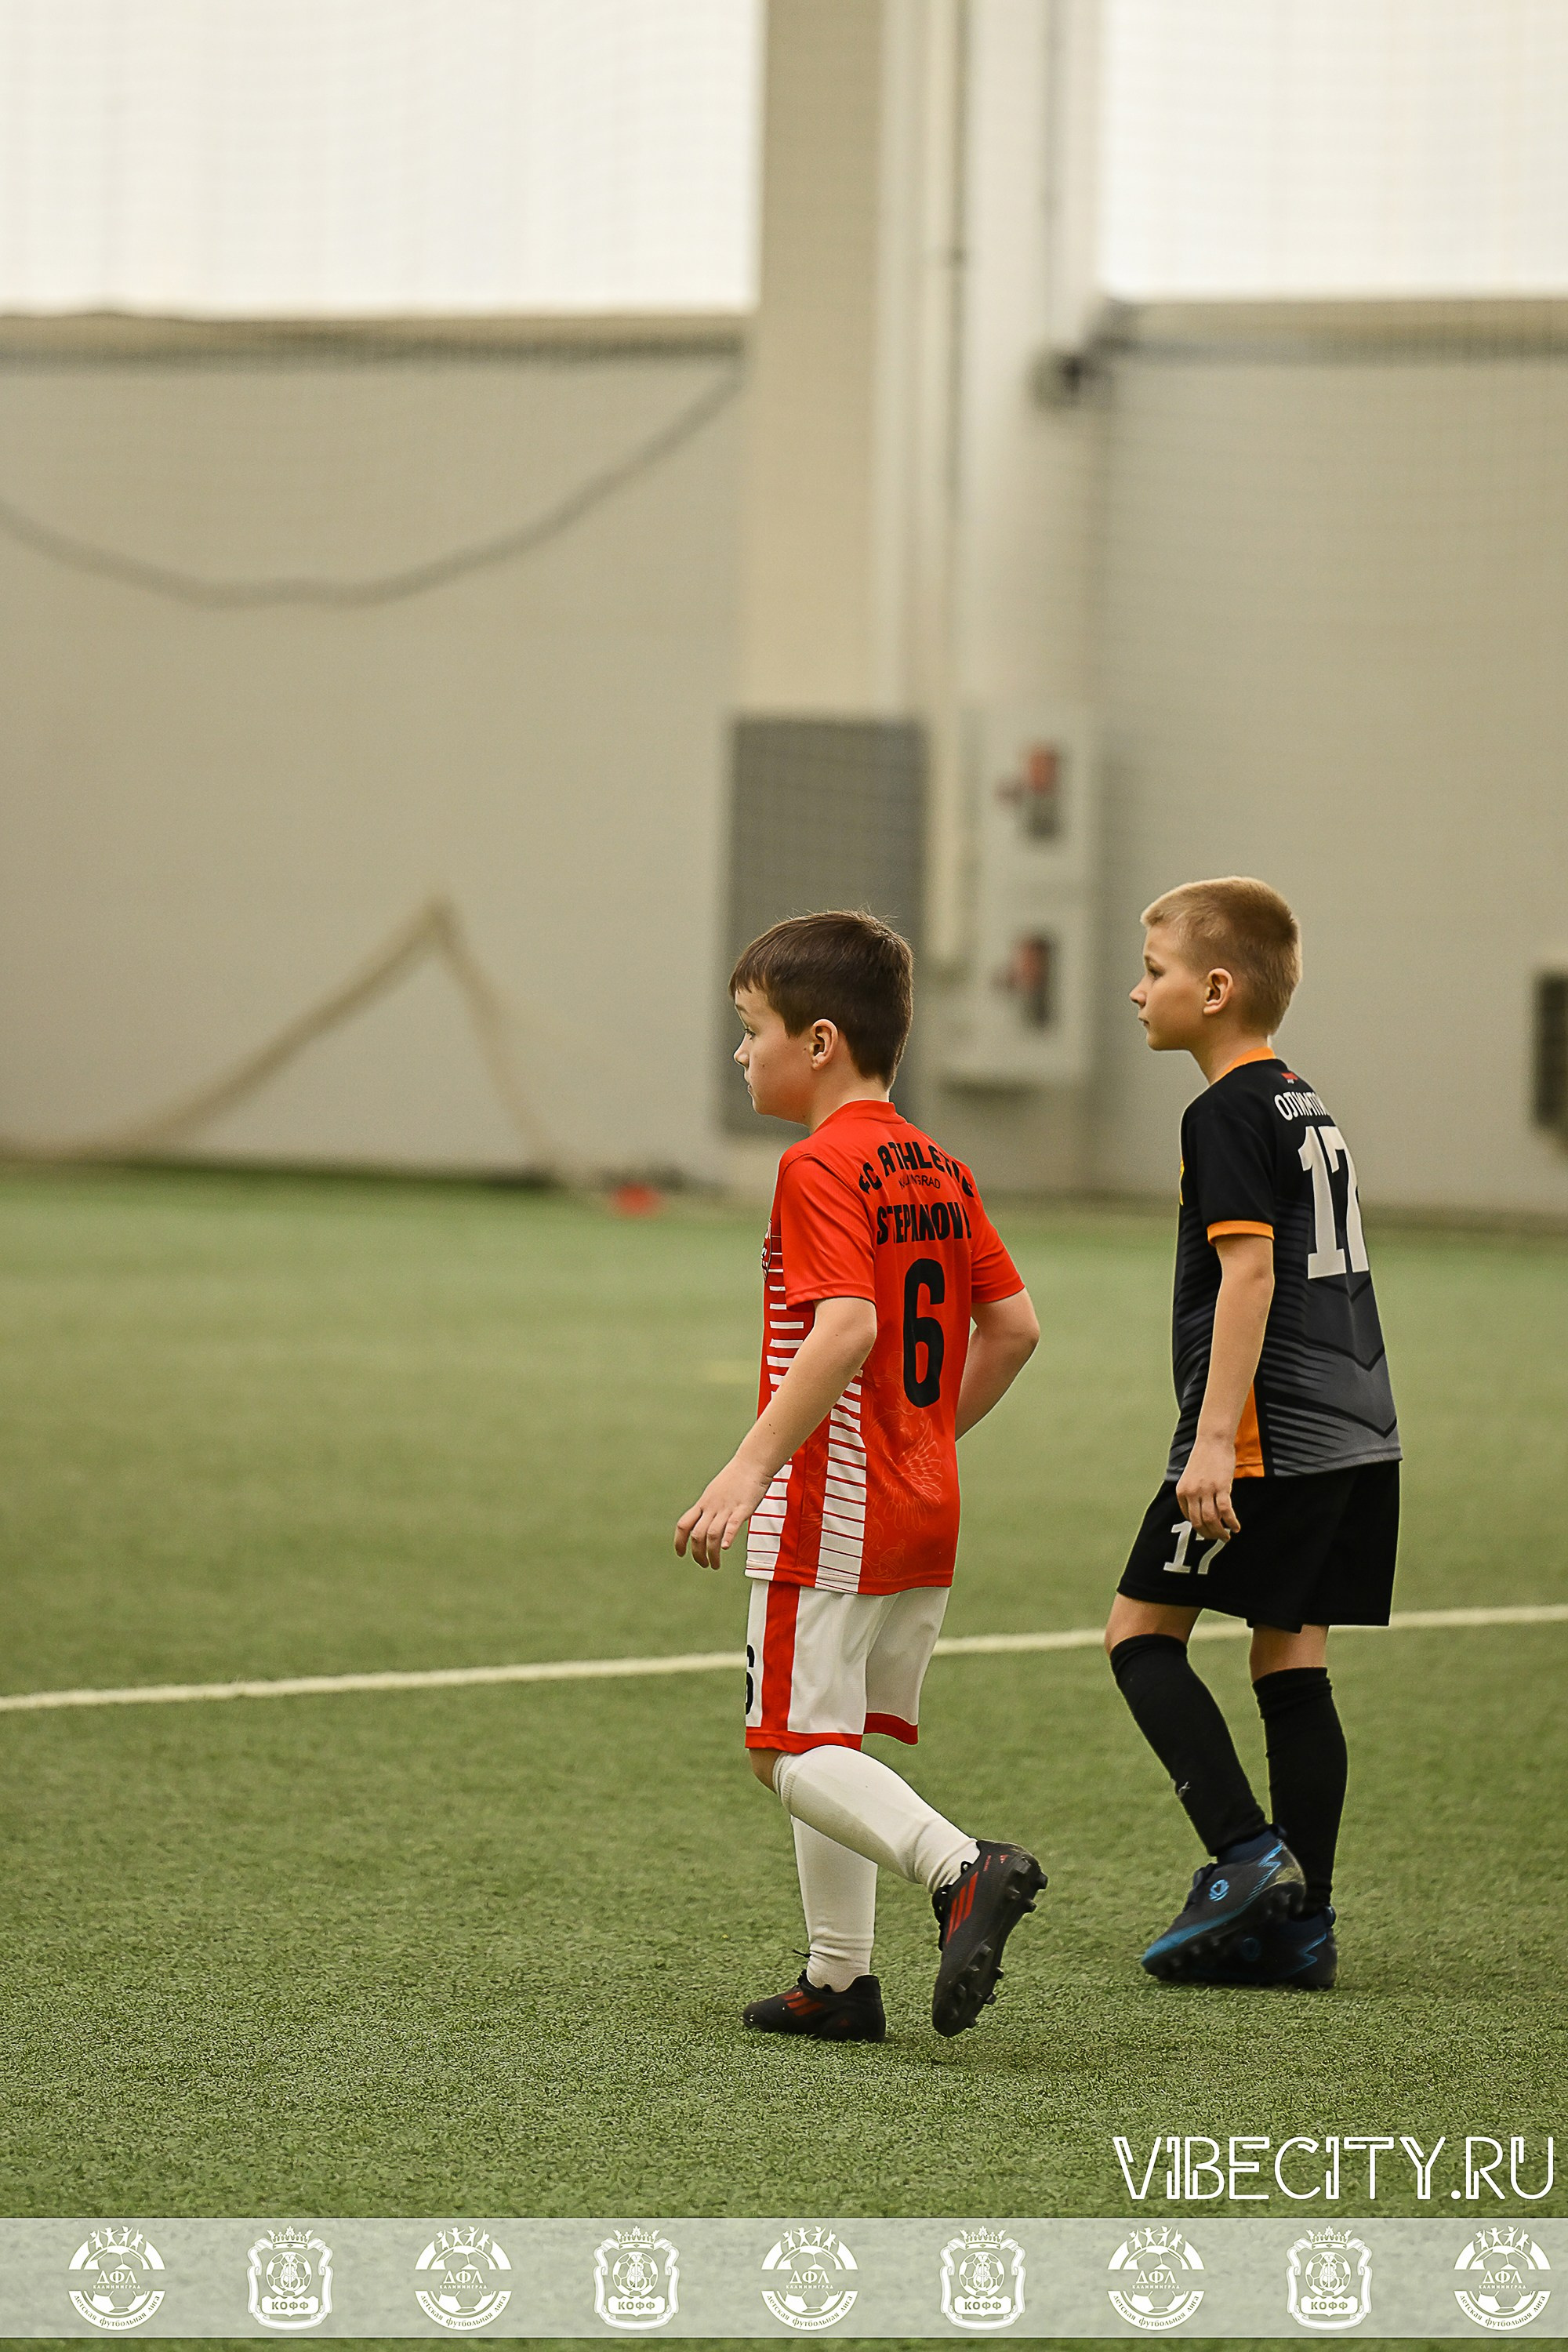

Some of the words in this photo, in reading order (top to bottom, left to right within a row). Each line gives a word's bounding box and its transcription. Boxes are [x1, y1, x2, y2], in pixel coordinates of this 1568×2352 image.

[1298, 1125, 1369, 1279] 17
[903, 1258, 946, 1408] 6
[1163, 1520, 1231, 1575] 17
